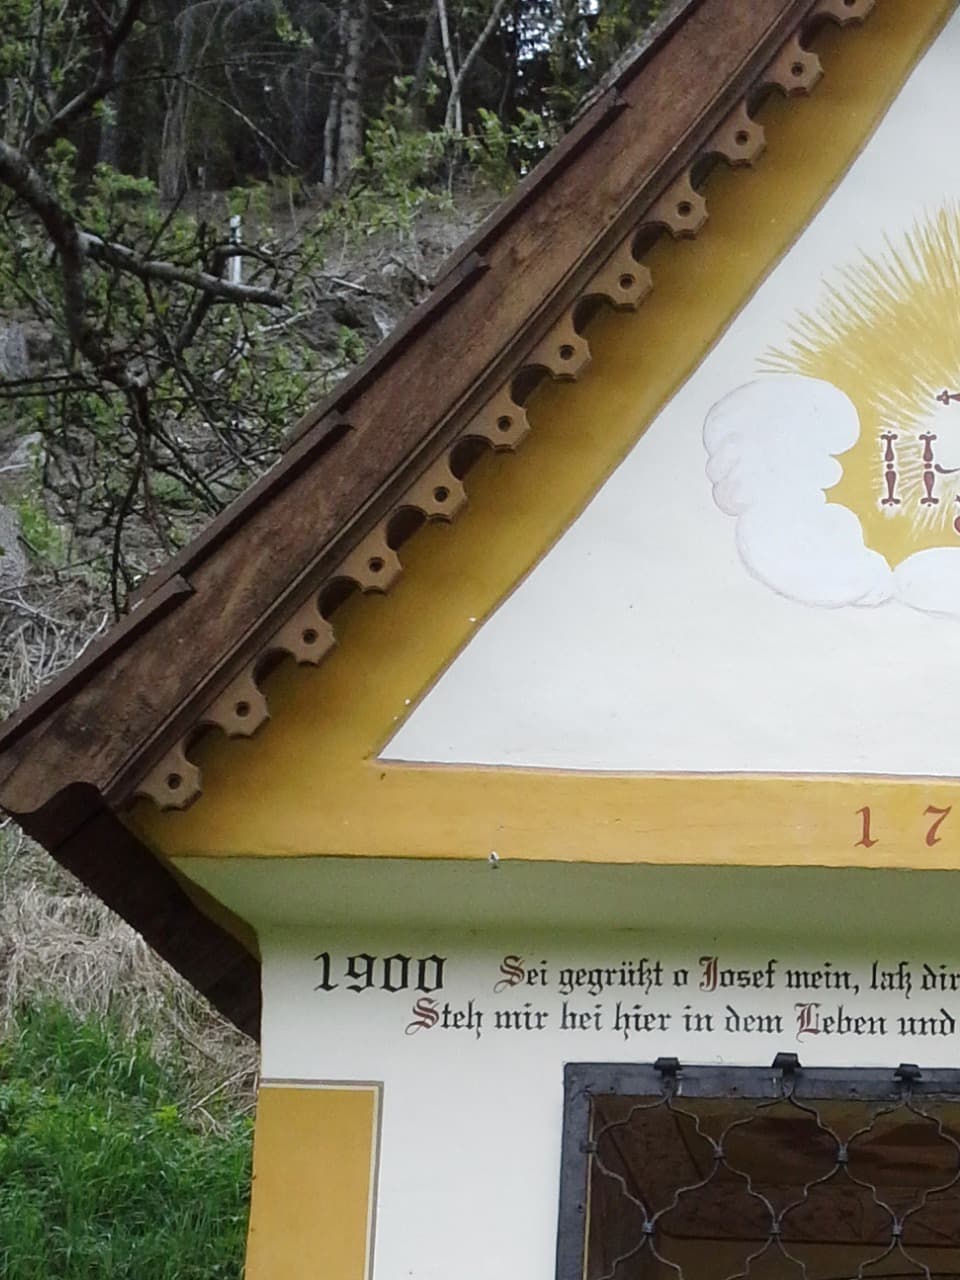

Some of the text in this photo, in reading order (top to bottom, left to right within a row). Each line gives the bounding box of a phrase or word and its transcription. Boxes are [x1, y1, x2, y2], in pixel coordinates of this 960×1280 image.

[314, 952, 447, 993] 1900
[494, 955, 548, 993] Sei
[558, 957, 663, 995] gegrüßt
[672, 971, 689, 988] o
[699, 957, 778, 992] Josef
[785, 963, 859, 995] mein,
[404, 997, 482, 1040] Steh
[493, 1003, 549, 1031] mir
[560, 1001, 603, 1031] bei
[612, 1001, 672, 1040] hier
[682, 1005, 715, 1033] in
[725, 1005, 784, 1034] dem
[795, 1002, 888, 1043] Leben
[896, 1008, 955, 1038] und
